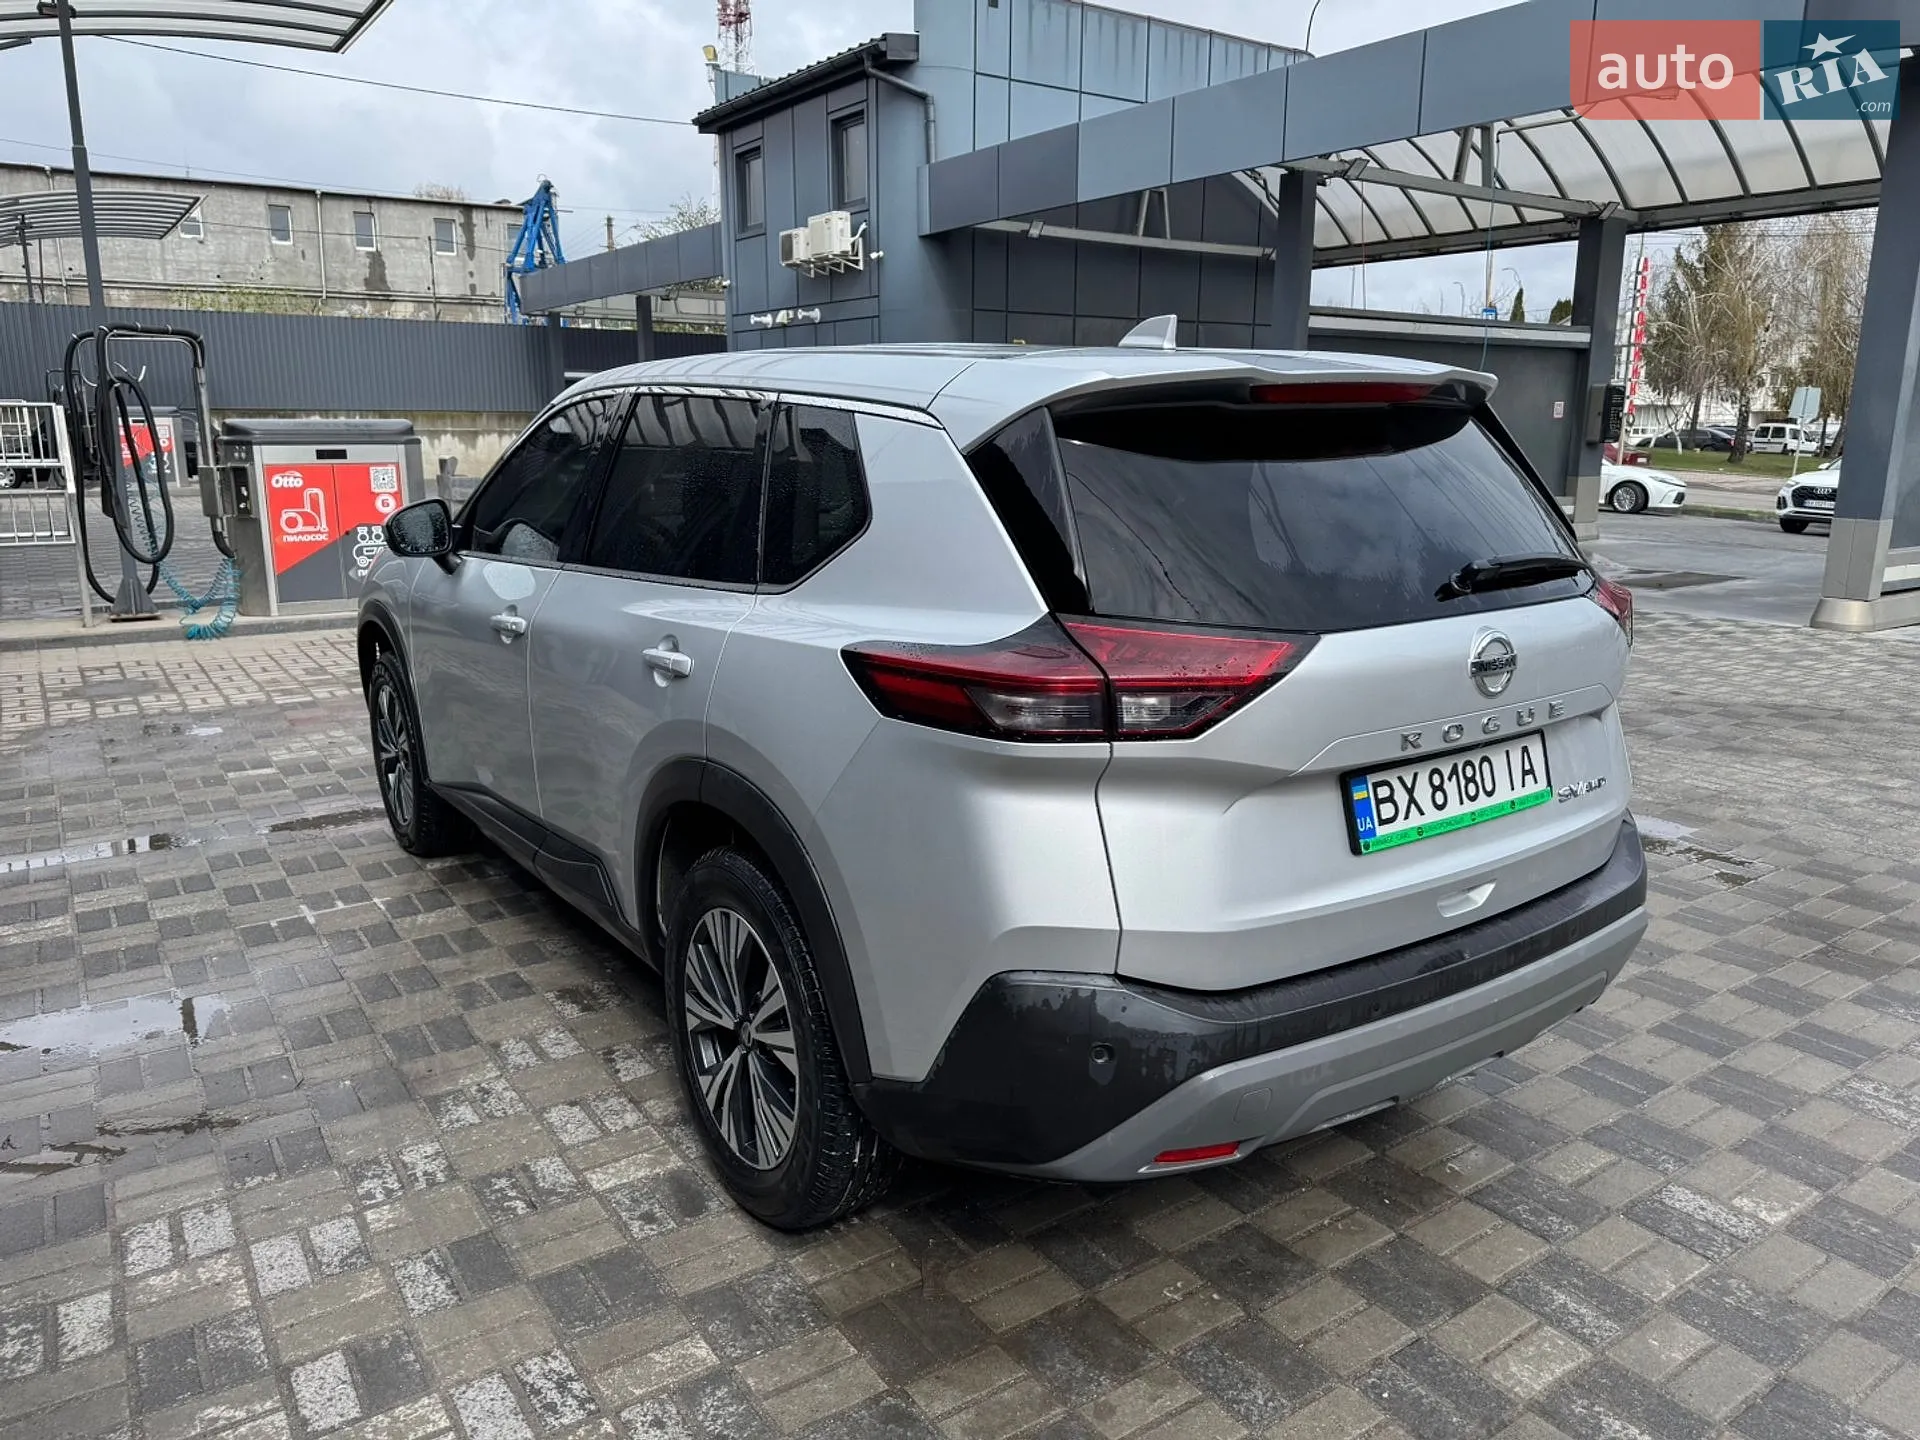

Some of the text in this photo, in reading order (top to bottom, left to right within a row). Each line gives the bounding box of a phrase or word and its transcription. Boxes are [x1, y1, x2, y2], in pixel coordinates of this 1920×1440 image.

[1400, 700, 1565, 751] ROGUE
[1428, 755, 1497, 811] 8180
[1357, 818, 1374, 832] UA
